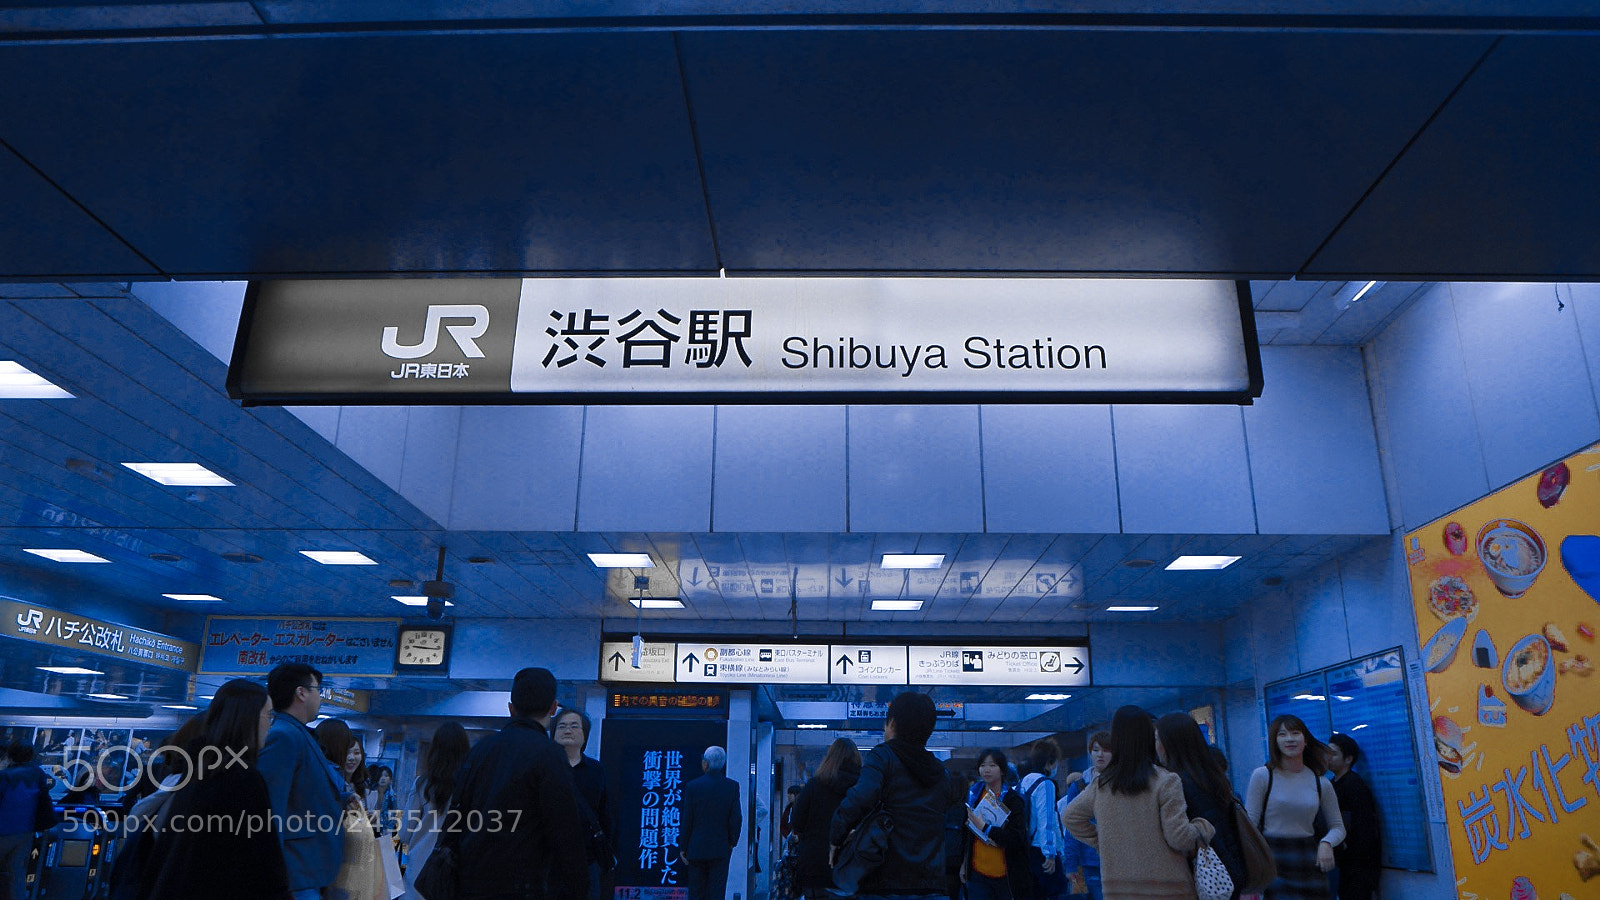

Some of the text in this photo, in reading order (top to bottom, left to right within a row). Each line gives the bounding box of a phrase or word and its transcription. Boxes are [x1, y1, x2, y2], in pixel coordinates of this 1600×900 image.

[381, 304, 490, 359] JR
[541, 308, 754, 370] 渋谷駅
[780, 336, 1108, 377] Shibuya Station
[389, 362, 471, 379] JR東日本
[17, 609, 43, 629] JR
[45, 616, 125, 652] ハチ公改札
[156, 640, 183, 654] Entrance
[720, 648, 751, 657] 副都心線
[774, 649, 824, 657] 東口バスターミナル
[940, 651, 959, 659] JR線
[987, 651, 1038, 660] みどりの窓口
[858, 666, 902, 674] コインロッカー
[919, 660, 960, 668] きっぷうりば
[639, 751, 662, 869] 衝撃の問題作
[661, 751, 683, 884] 世界が絶賛した
